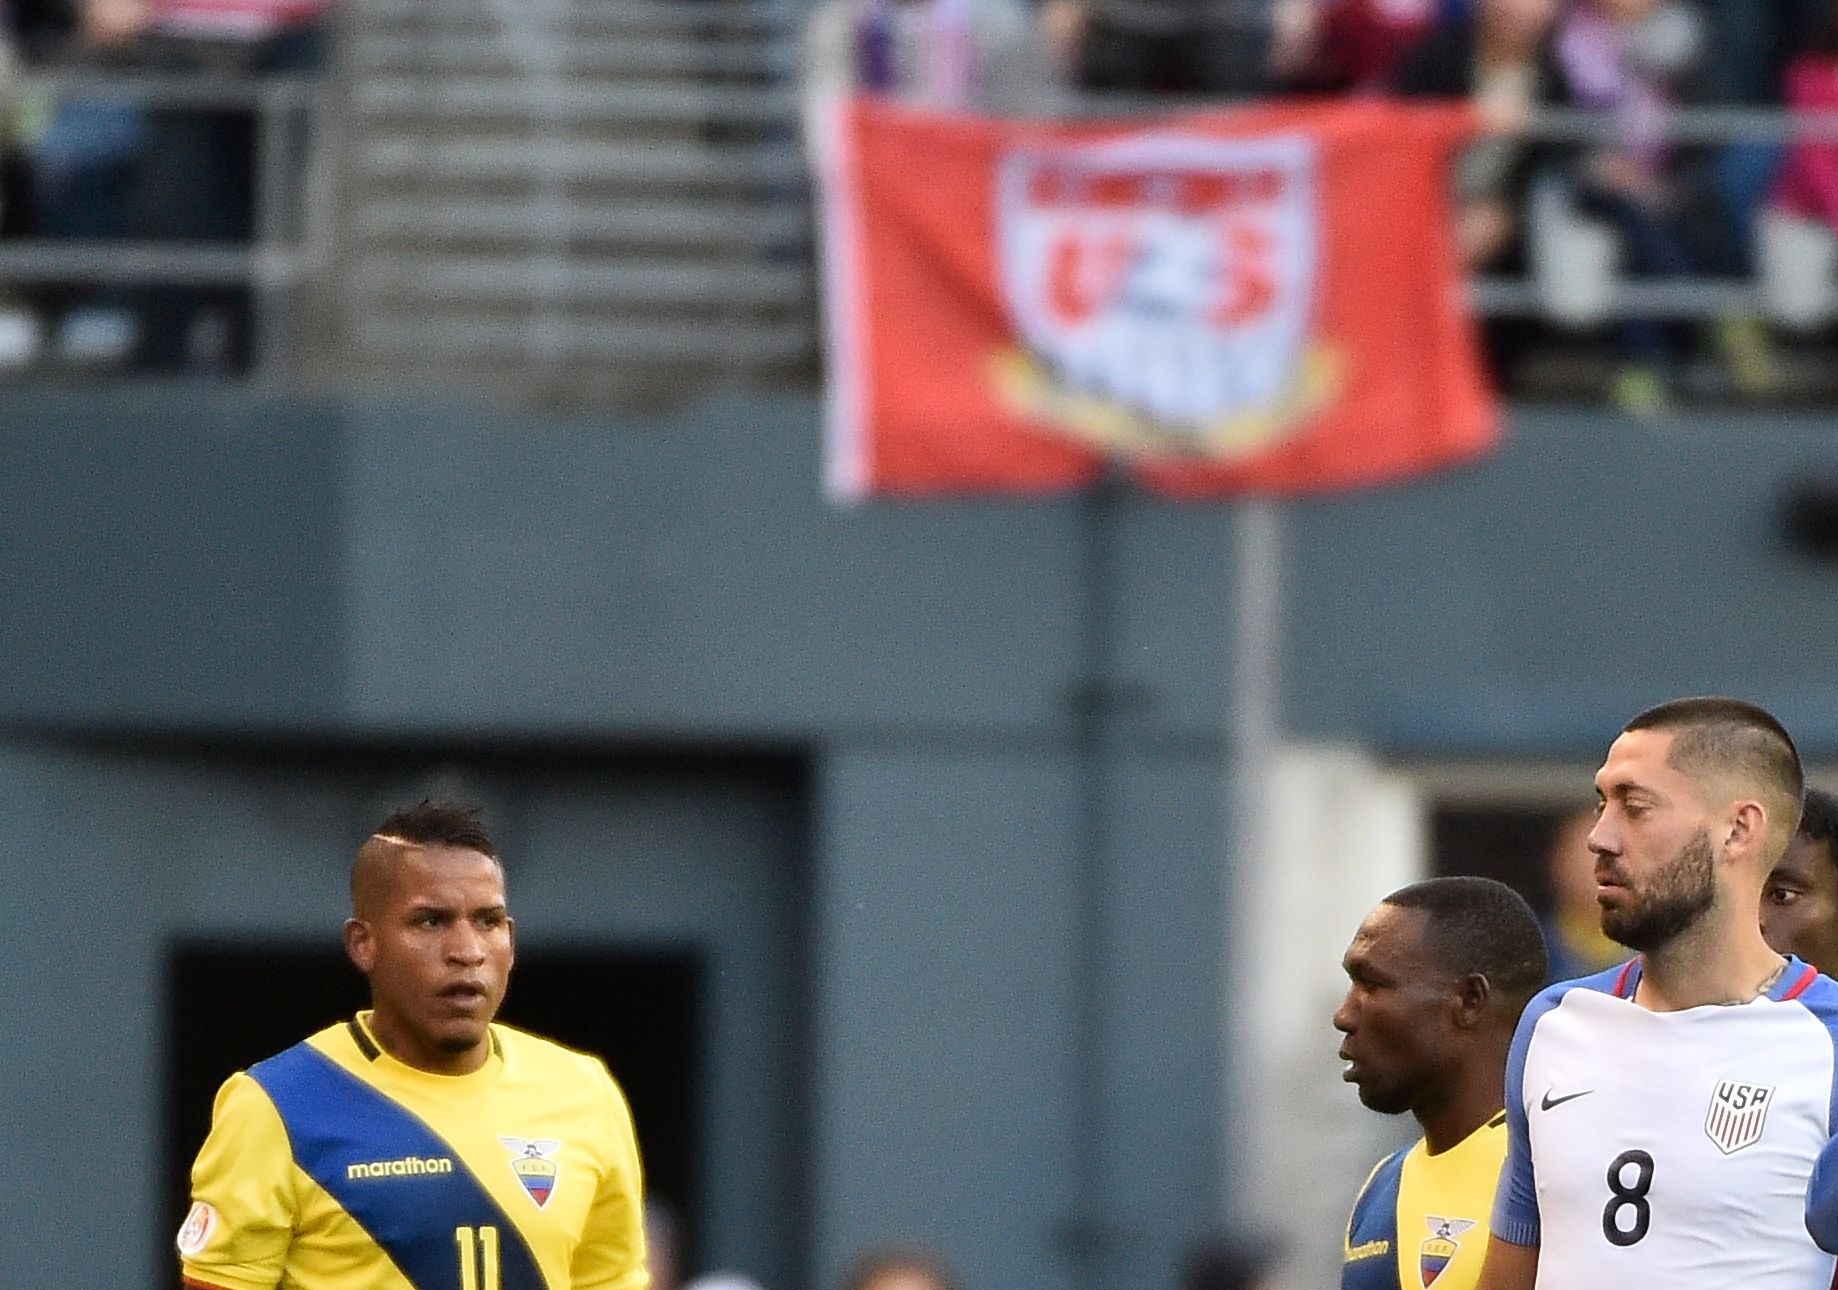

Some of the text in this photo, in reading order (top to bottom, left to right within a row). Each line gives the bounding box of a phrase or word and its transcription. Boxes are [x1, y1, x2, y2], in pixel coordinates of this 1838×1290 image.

[1718, 1082, 1769, 1110] USA
[347, 1156, 452, 1179] marathon
[1602, 1149, 1655, 1247] 8
